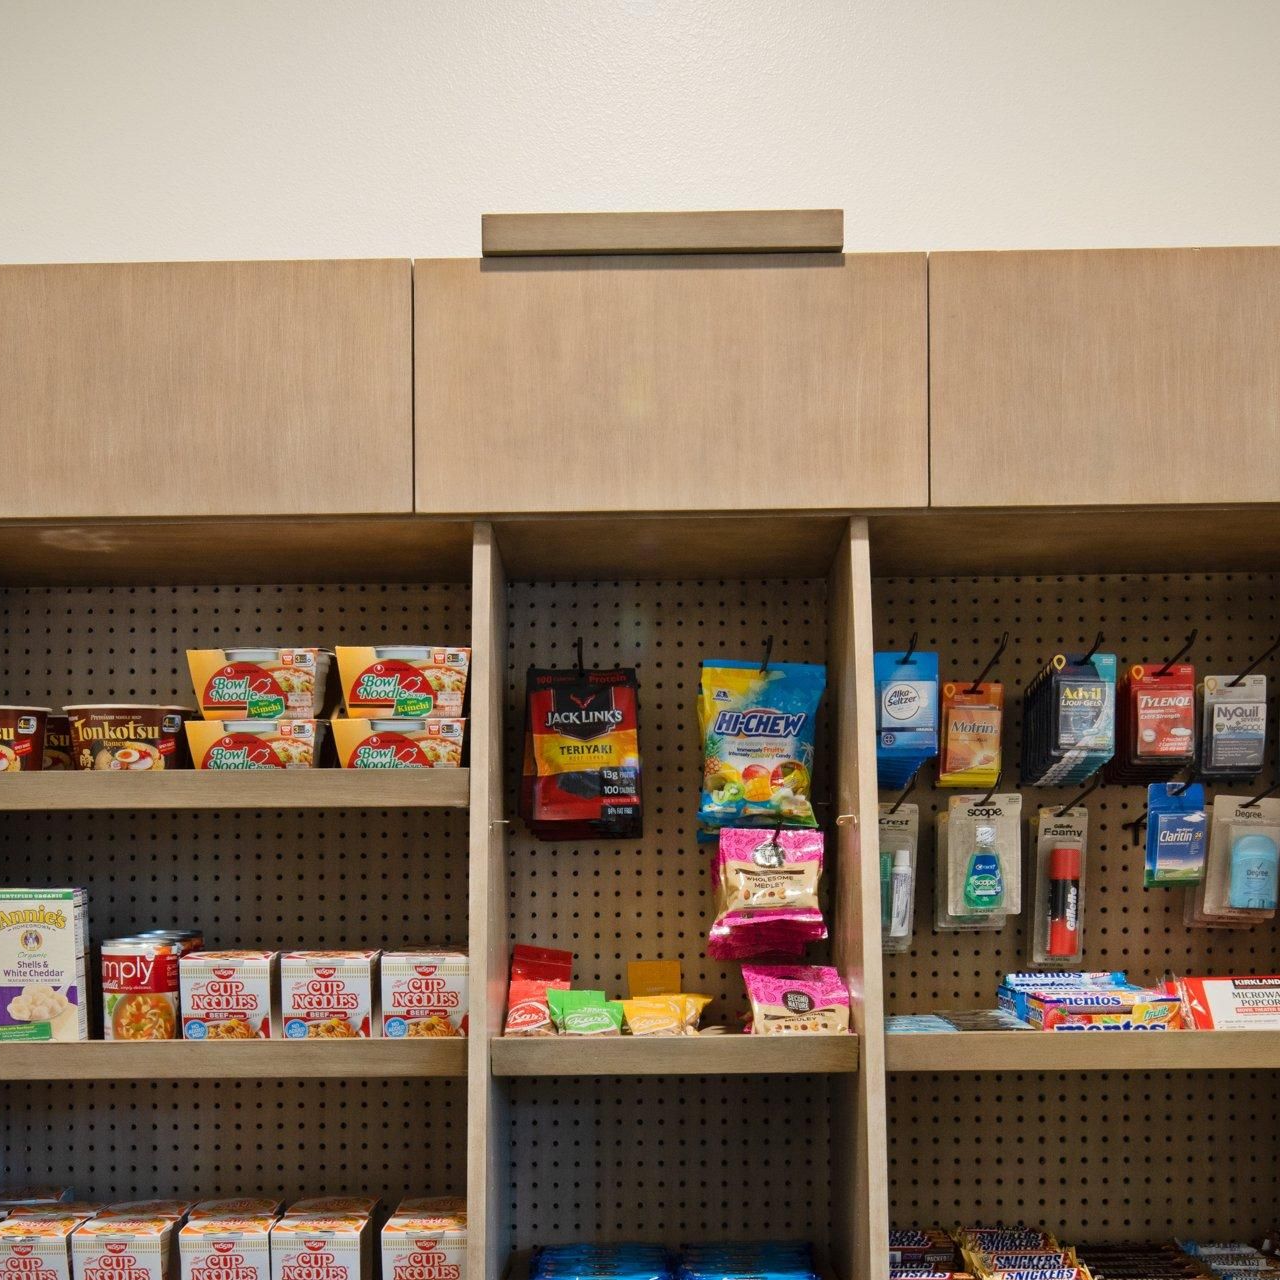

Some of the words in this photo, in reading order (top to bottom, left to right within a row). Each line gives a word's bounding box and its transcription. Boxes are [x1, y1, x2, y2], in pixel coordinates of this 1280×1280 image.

[213, 677, 249, 690] Bowl
[361, 674, 398, 688] Bowl
[211, 689, 257, 701] Noodle
[358, 685, 406, 699] Noodle
[890, 689, 913, 700] Alka-
[1061, 687, 1102, 700] Advil
[887, 695, 917, 707] Seltzer
[1139, 695, 1191, 707] TYLENOL
[250, 704, 281, 714] Kimchi
[1216, 706, 1259, 719] NyQuil
[546, 711, 580, 726] JACK
[582, 710, 623, 723] LINK'S
[714, 711, 807, 738] HI-CHEW
[74, 719, 160, 741] Tonkotsu
[951, 721, 994, 735] Motrin
[211, 747, 248, 761] Bowl
[358, 746, 394, 760] Bowl
[559, 745, 613, 755] TERIYAKI
[763, 746, 784, 754] Fruity
[967, 806, 1002, 818] scope
[1235, 809, 1262, 820] Degree
[879, 818, 910, 826] Crest
[1043, 828, 1083, 838] Foamy
[1160, 830, 1193, 842] Claritin
[745, 875, 794, 883] WHOLESOME
[754, 881, 785, 889] MEDLEY
[17, 961, 41, 969] Shells
[3, 969, 27, 977] White
[28, 969, 65, 977] Cheddar
[206, 981, 244, 996] CUP
[307, 980, 345, 995] CUP
[407, 978, 445, 993] CUP
[1235, 979, 1280, 987] KIRKLAND
[192, 994, 258, 1011] NOODLES
[292, 993, 359, 1010] NOODLES
[392, 991, 459, 1008] NOODLES
[787, 994, 808, 1003] SECOND
[1059, 996, 1121, 1006] mentos
[1143, 1006, 1168, 1020] fruit
[5, 1257, 43, 1272] CUP
[98, 1255, 136, 1271] CUP
[206, 1254, 244, 1269] CUP
[296, 1252, 334, 1268] CUP
[393, 1264, 460, 1280] NOODLES
